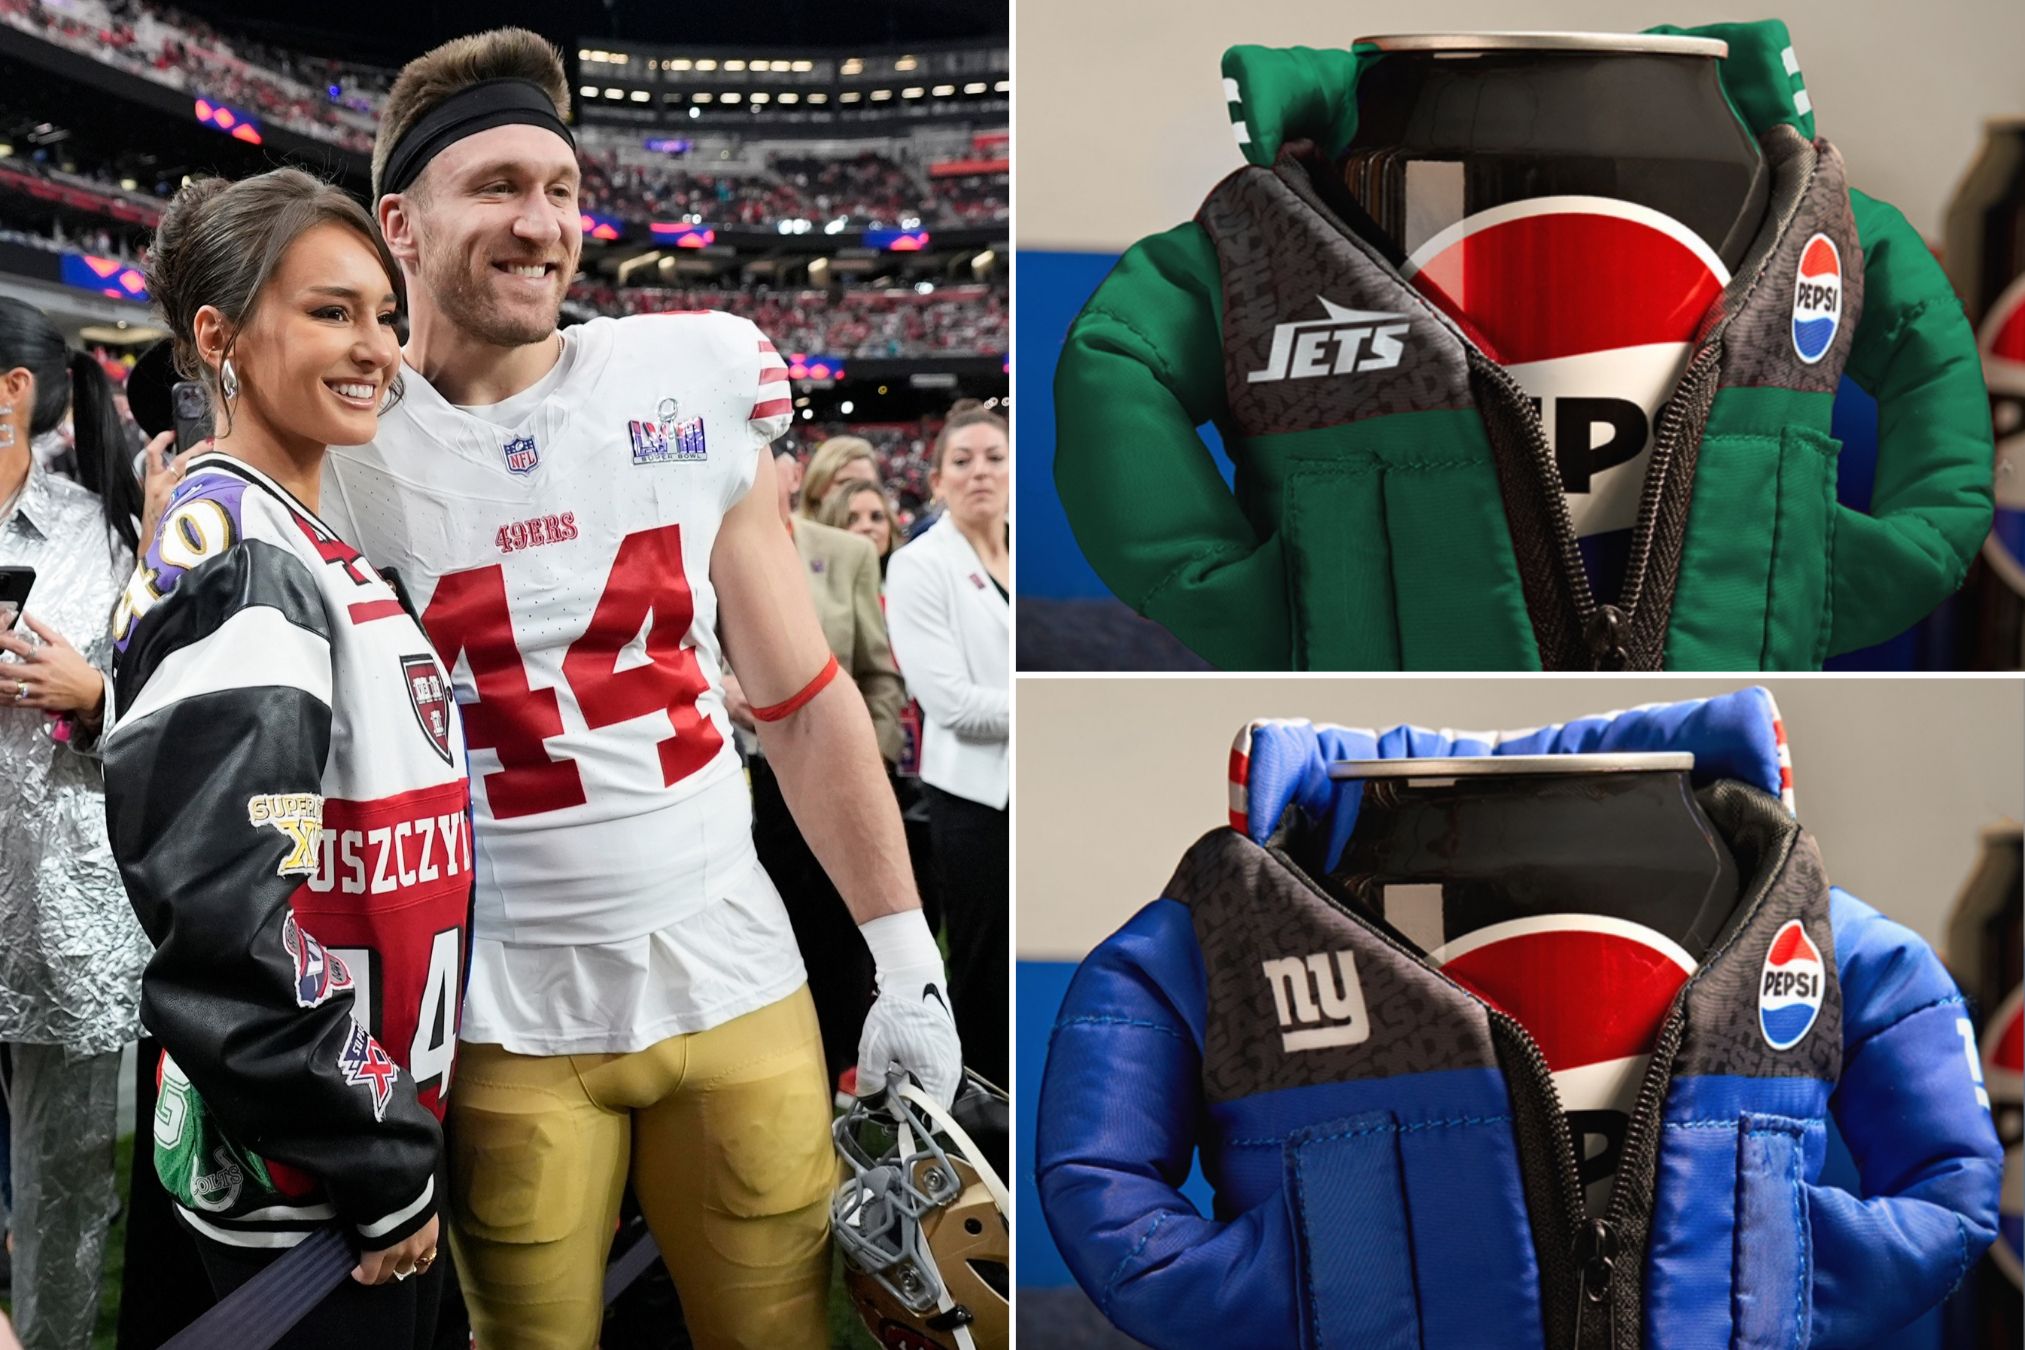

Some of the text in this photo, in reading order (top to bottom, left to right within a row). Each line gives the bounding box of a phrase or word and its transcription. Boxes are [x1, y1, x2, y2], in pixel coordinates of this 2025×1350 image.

[1797, 281, 1838, 312] PEPSI
[1246, 294, 1410, 383] JETS
[510, 450, 535, 469] NFL
[677, 452, 702, 460] BOWL
[495, 511, 579, 554] 49ERS
[421, 523, 724, 821] 44
[251, 796, 316, 822] SUPER
[1763, 971, 1819, 998] PEPSI
